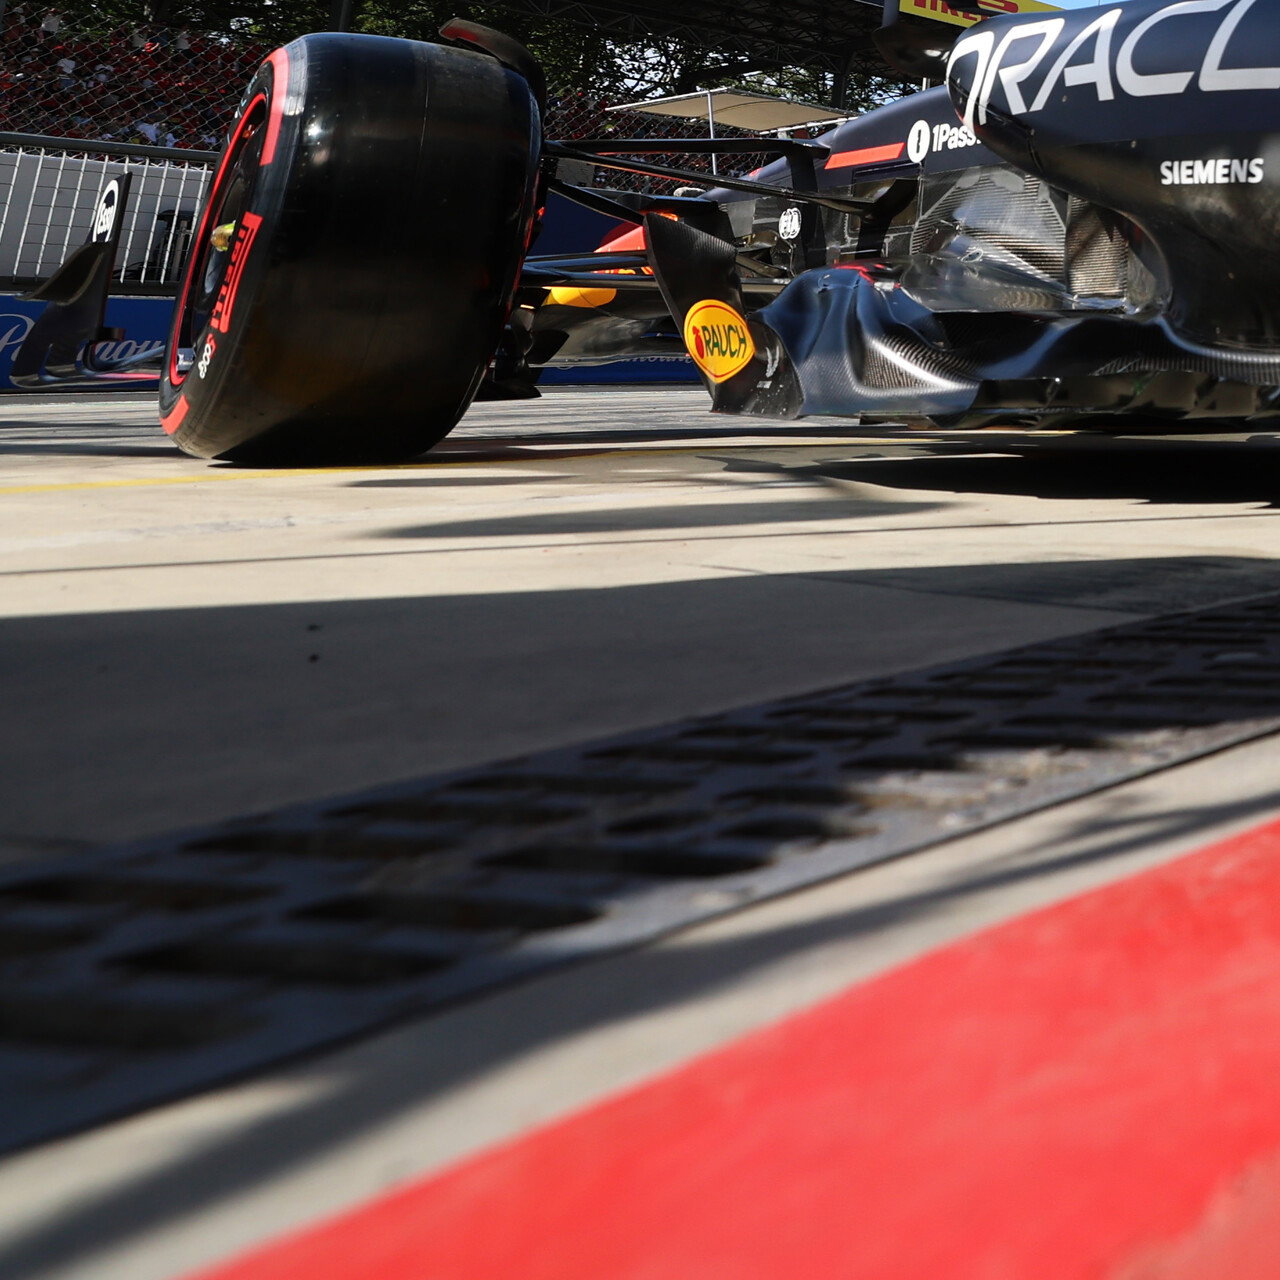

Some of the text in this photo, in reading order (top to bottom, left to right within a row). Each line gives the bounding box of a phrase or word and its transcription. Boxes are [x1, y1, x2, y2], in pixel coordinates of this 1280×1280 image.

[932, 123, 982, 152] 1Pass
[1160, 157, 1265, 186] SIEMENS
[703, 324, 747, 360] RAUCH
